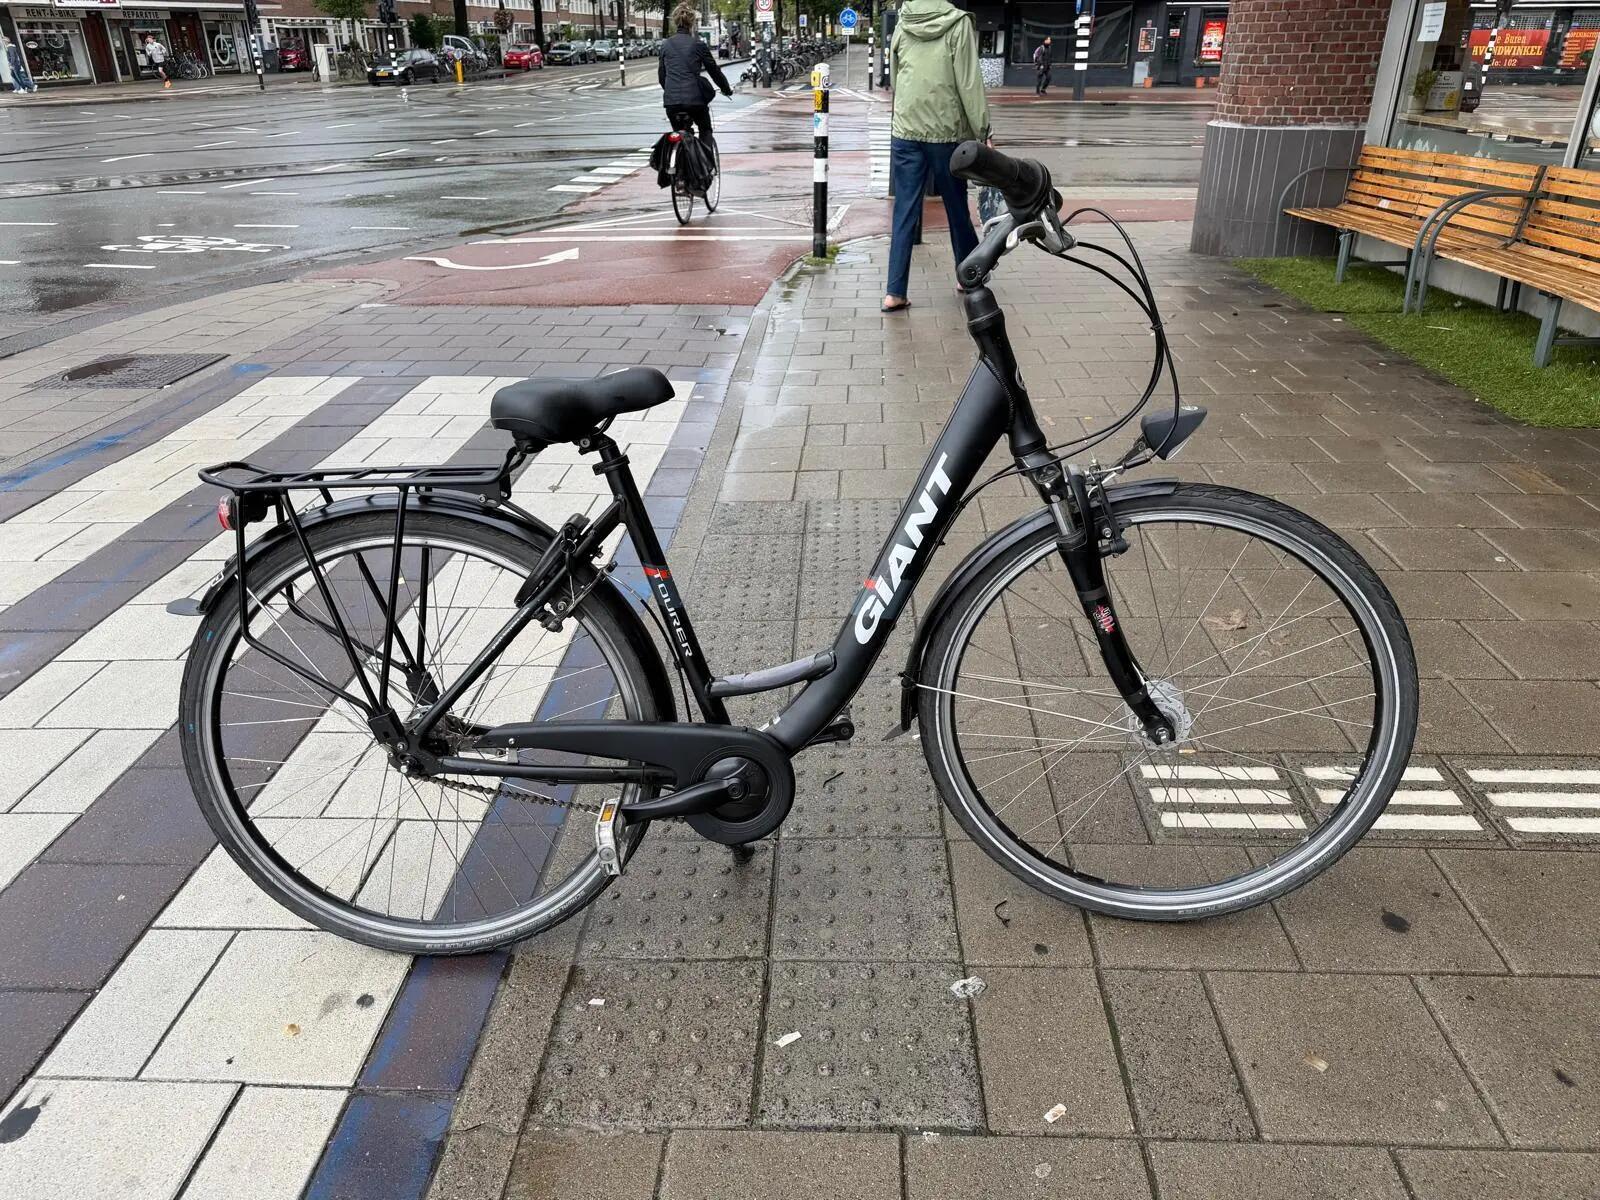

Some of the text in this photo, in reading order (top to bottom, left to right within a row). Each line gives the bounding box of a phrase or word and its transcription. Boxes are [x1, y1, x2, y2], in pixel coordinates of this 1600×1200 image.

[122, 11, 160, 19] REPARATIE
[1472, 45, 1543, 56] AVNDWINKEL
[1503, 59, 1518, 67] 102
[855, 451, 952, 645] GIANT
[654, 568, 693, 657] TOURER
